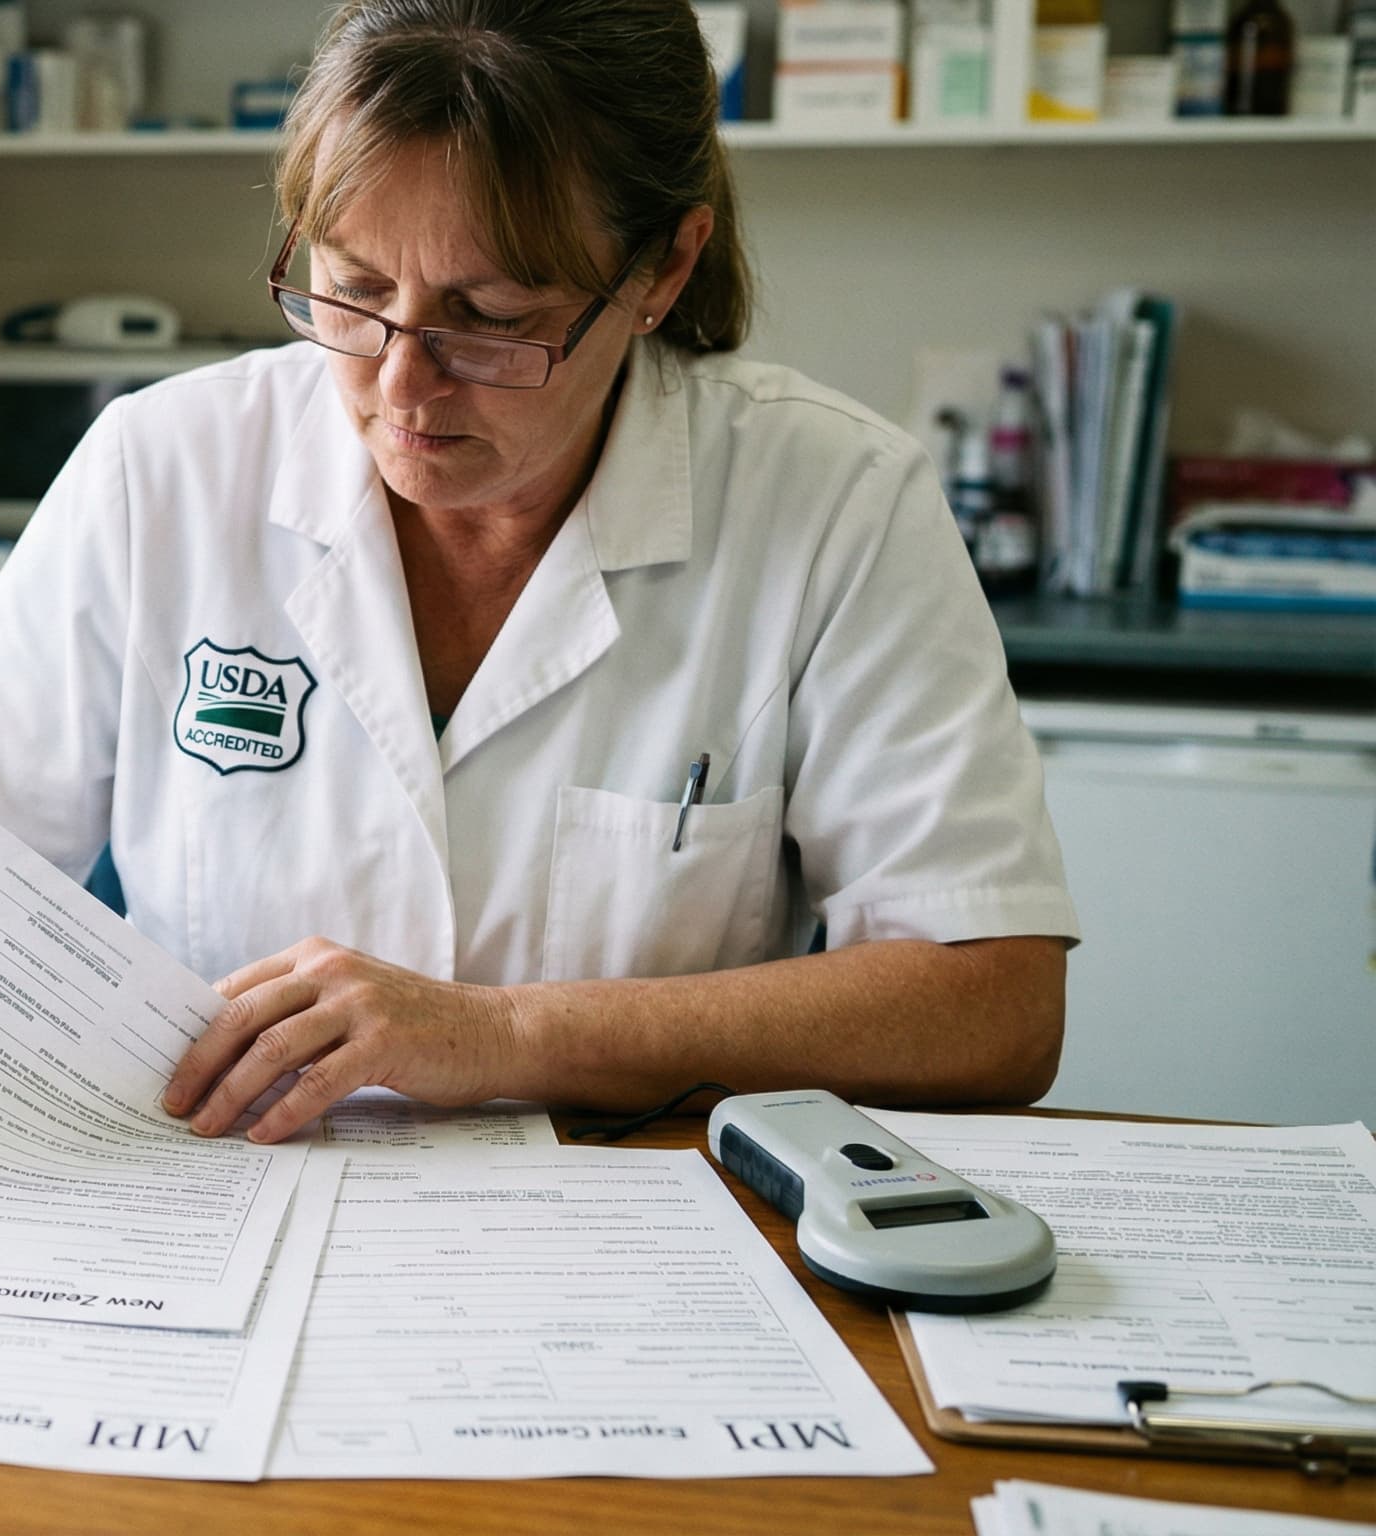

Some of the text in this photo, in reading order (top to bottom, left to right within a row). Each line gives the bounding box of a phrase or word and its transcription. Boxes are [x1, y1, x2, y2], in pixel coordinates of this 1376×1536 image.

[201, 660, 288, 704] USDA
[185, 728, 284, 760] ACCREDITED
[107, 1295, 165, 1312] New
[85, 1419, 213, 1453] MPI
[599, 1421, 689, 1440] Export
[723, 1421, 858, 1451] MPI
